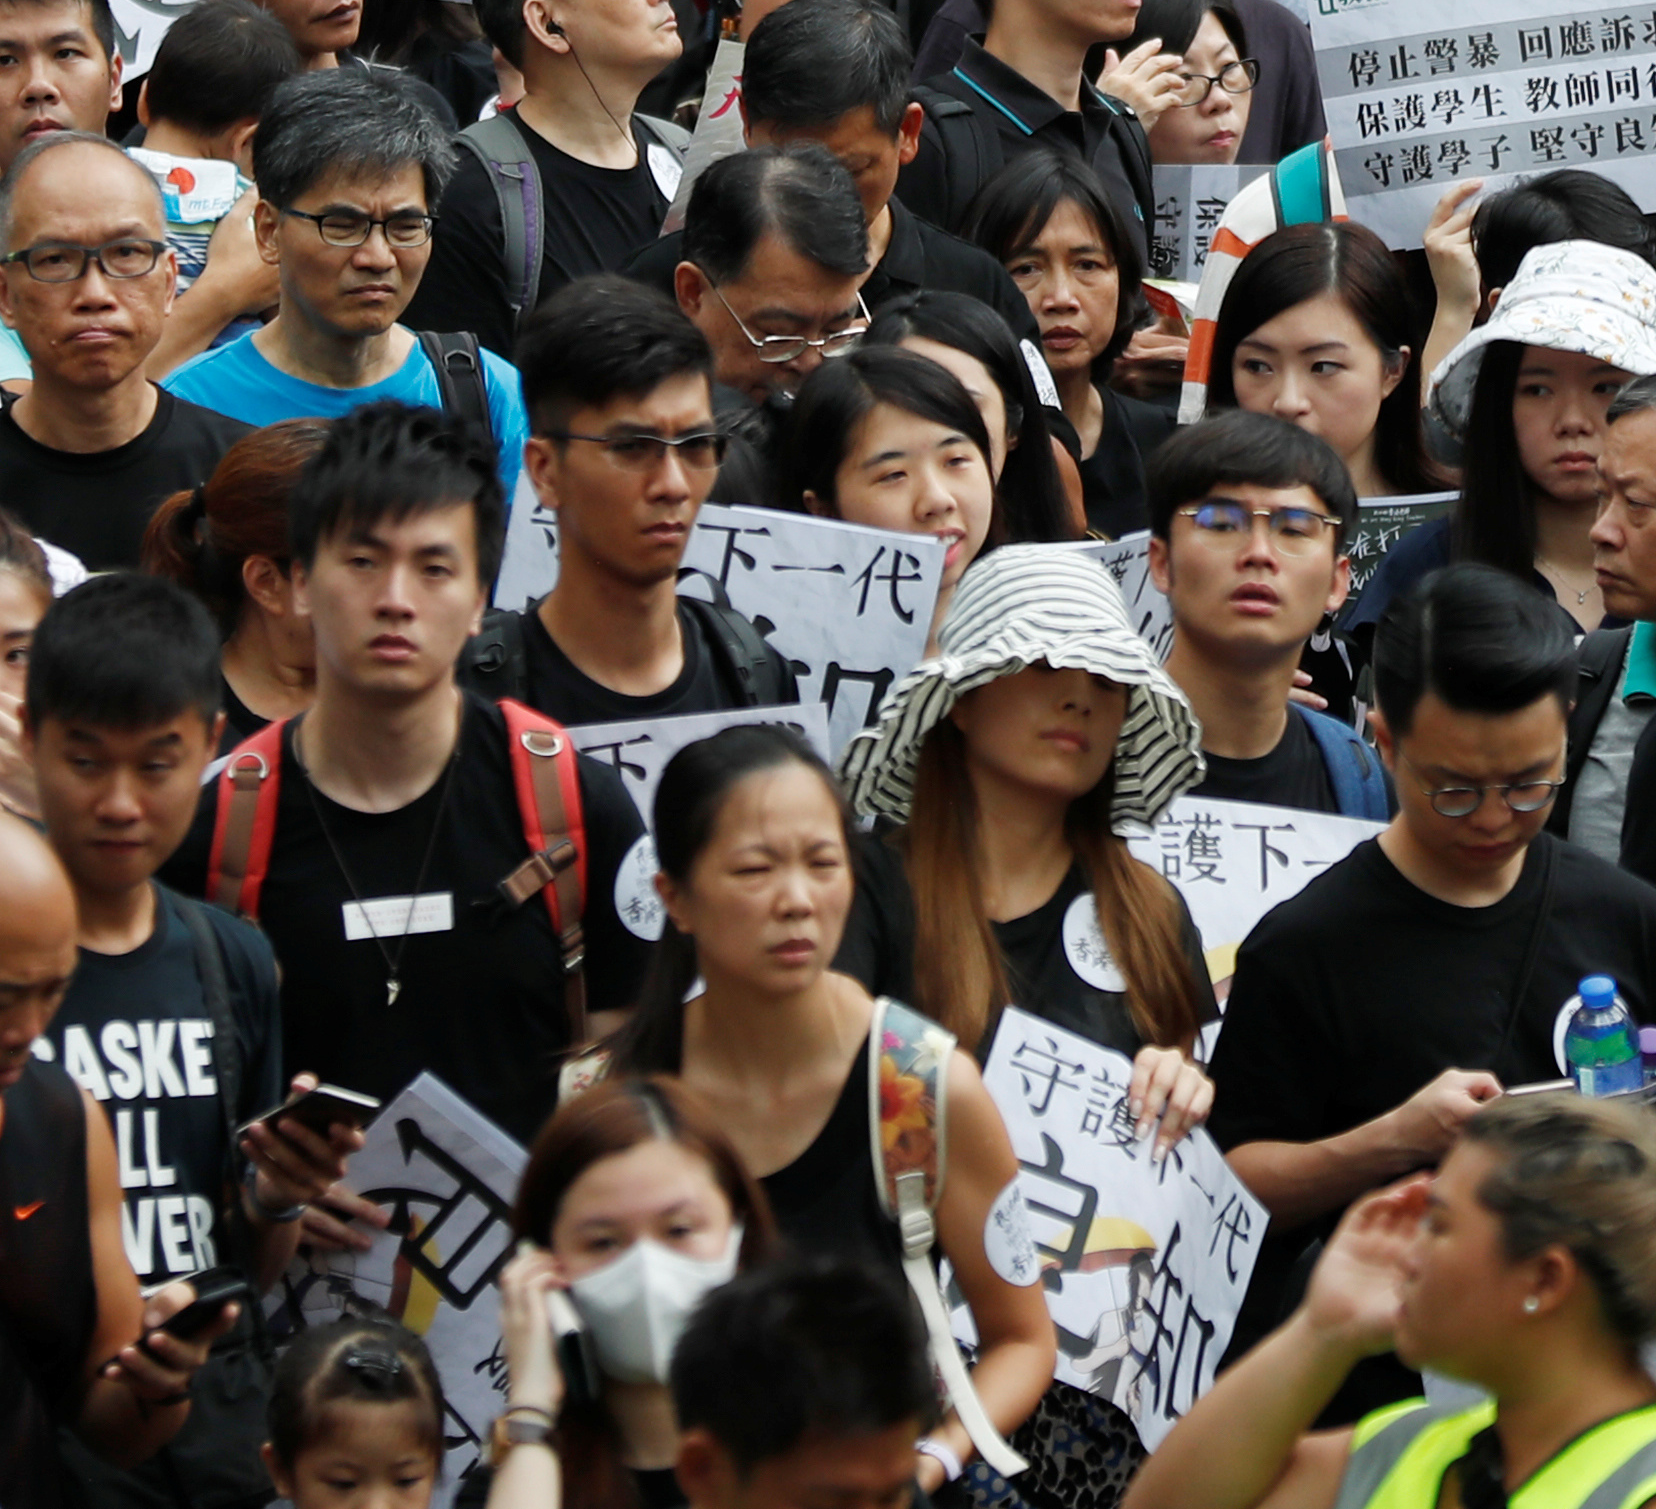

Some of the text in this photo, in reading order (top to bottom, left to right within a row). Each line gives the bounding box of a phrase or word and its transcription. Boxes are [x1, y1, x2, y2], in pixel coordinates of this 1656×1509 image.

[1347, 30, 1502, 88] 停止警暴
[1355, 82, 1509, 139] 保護學生
[1363, 130, 1512, 188] 守護學子
[694, 515, 923, 626] 下一代
